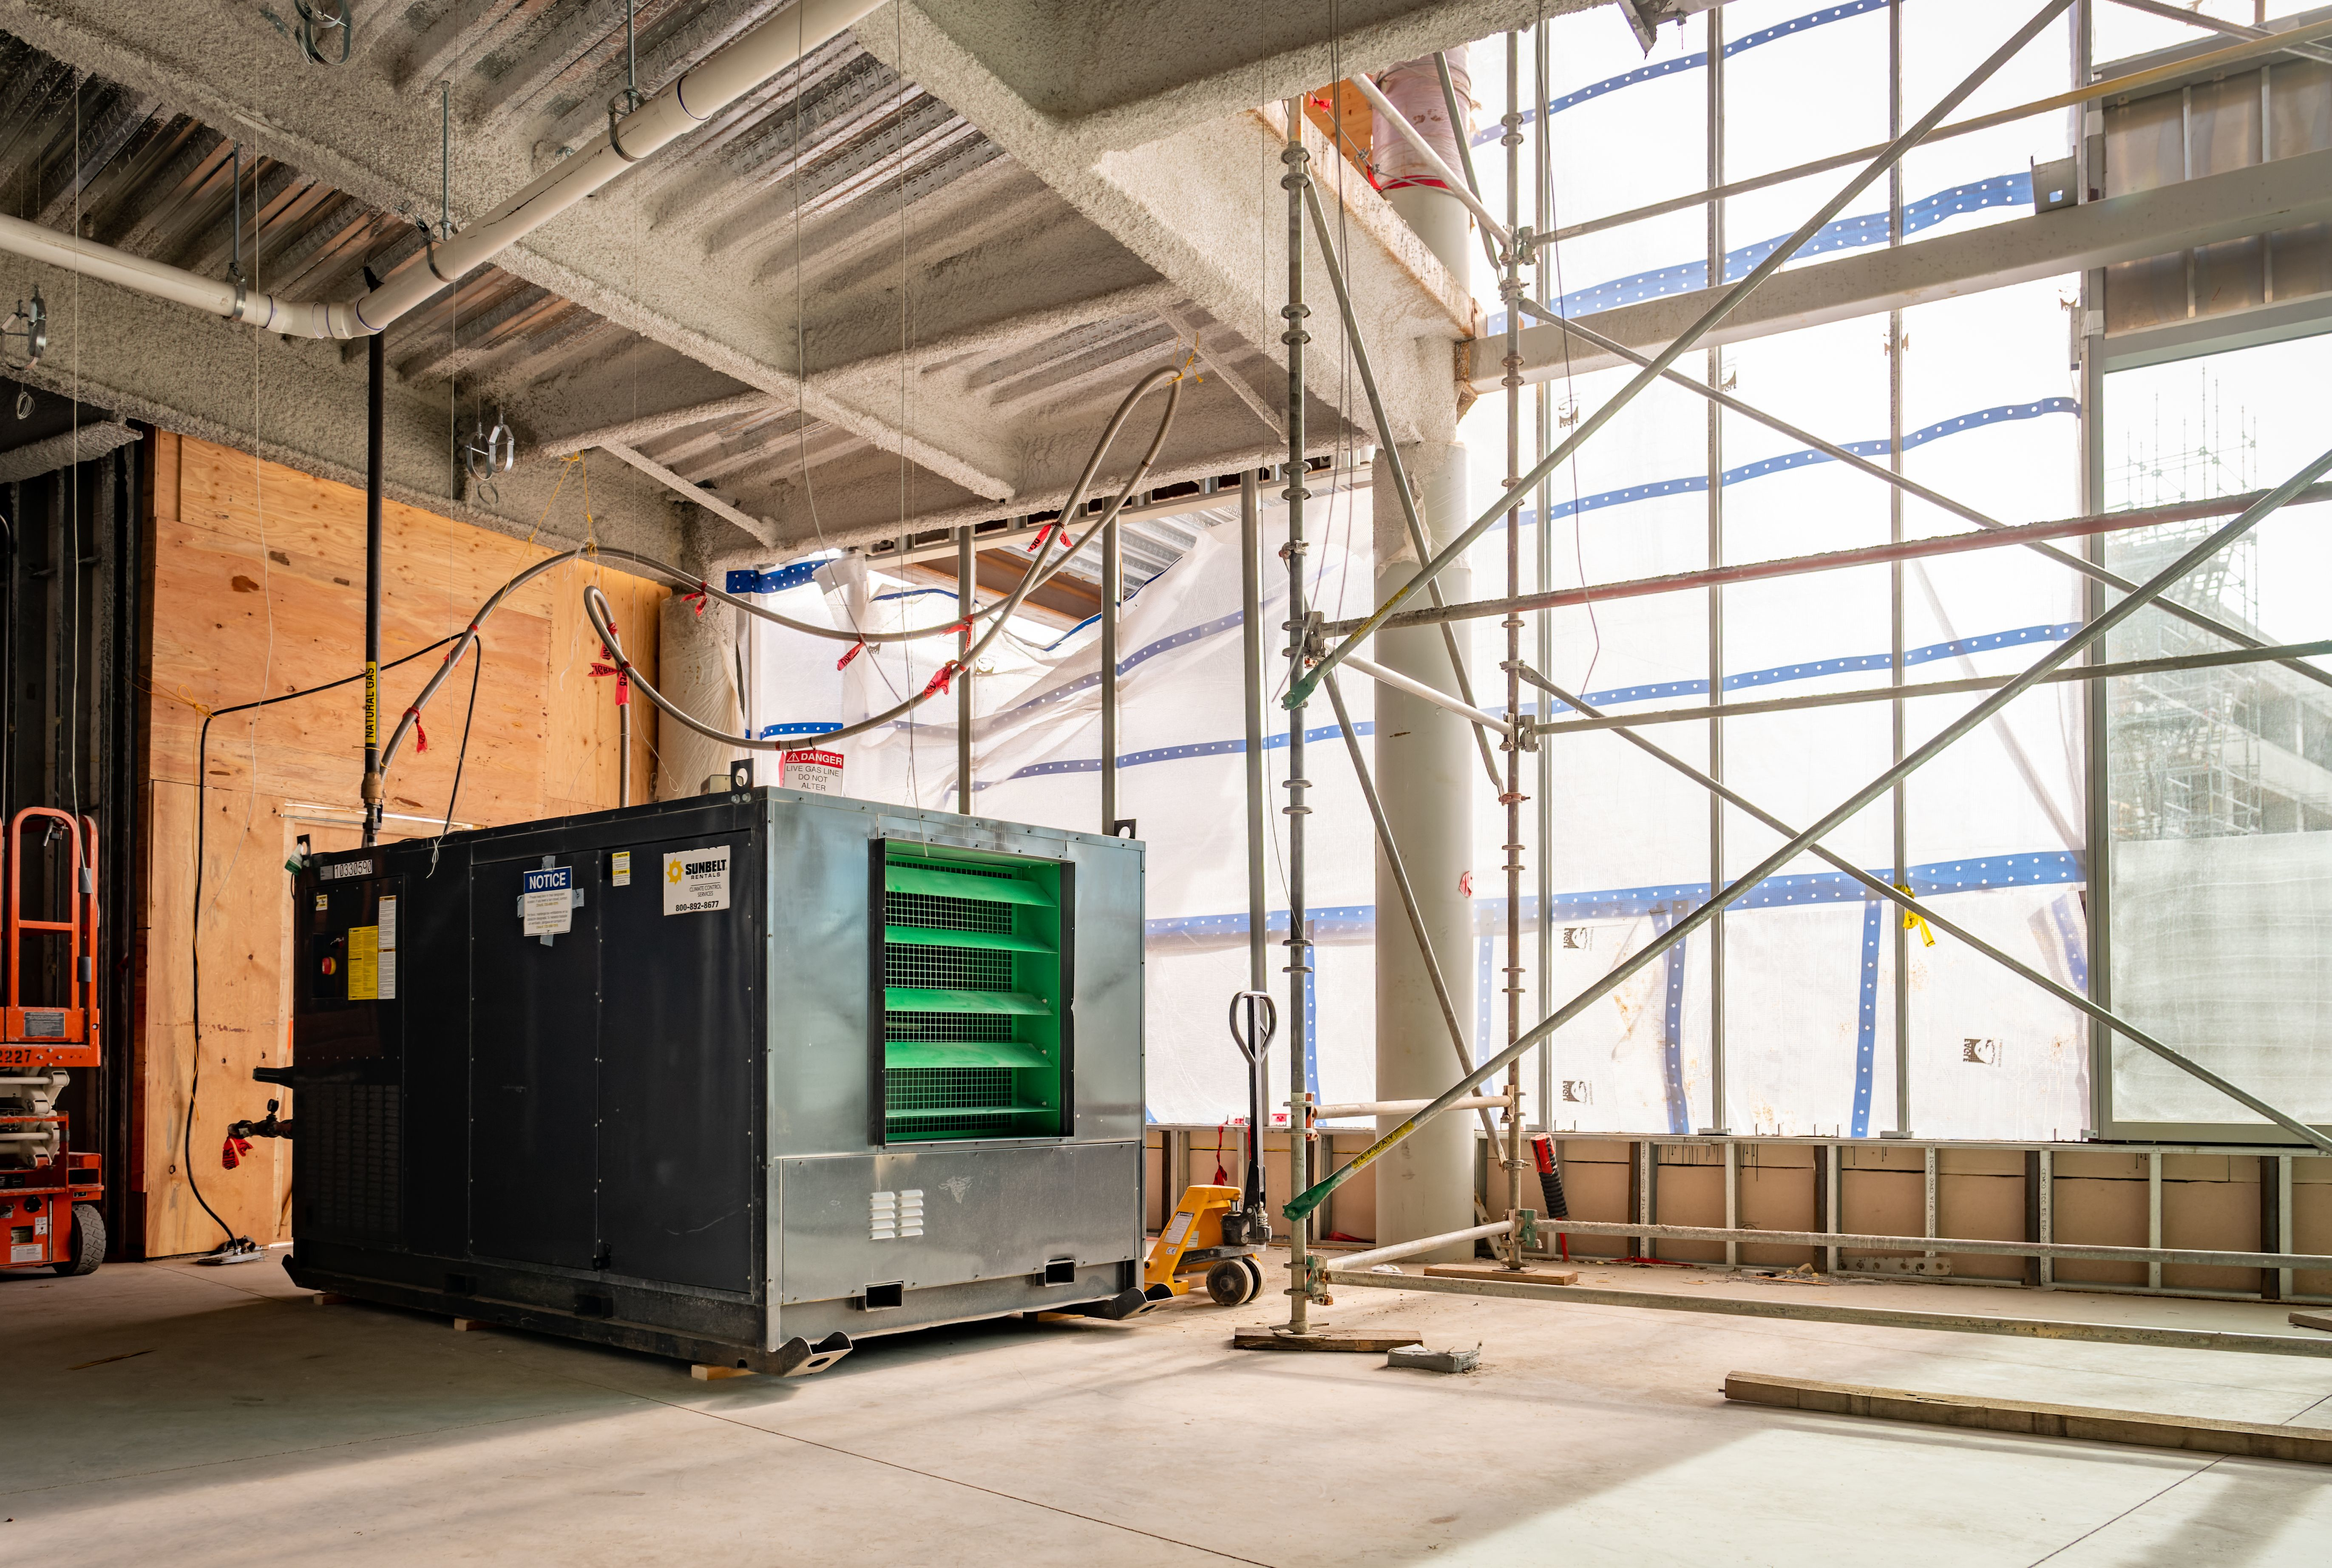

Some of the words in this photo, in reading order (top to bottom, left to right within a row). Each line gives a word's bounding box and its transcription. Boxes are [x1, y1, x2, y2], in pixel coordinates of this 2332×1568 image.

[366, 668, 374, 687] GAS
[365, 692, 374, 738] NATURAL
[800, 753, 843, 766] DANGER
[823, 768, 839, 777] LINE
[801, 783, 826, 791] ALTER
[335, 860, 372, 878] 10330590
[685, 859, 727, 875] SUNBELT
[529, 872, 566, 890] NOTICE
[675, 900, 719, 912] 800-892-8677
[1353, 1134, 1394, 1165] SAFWAY
[2041, 1208, 2046, 1216] ES
